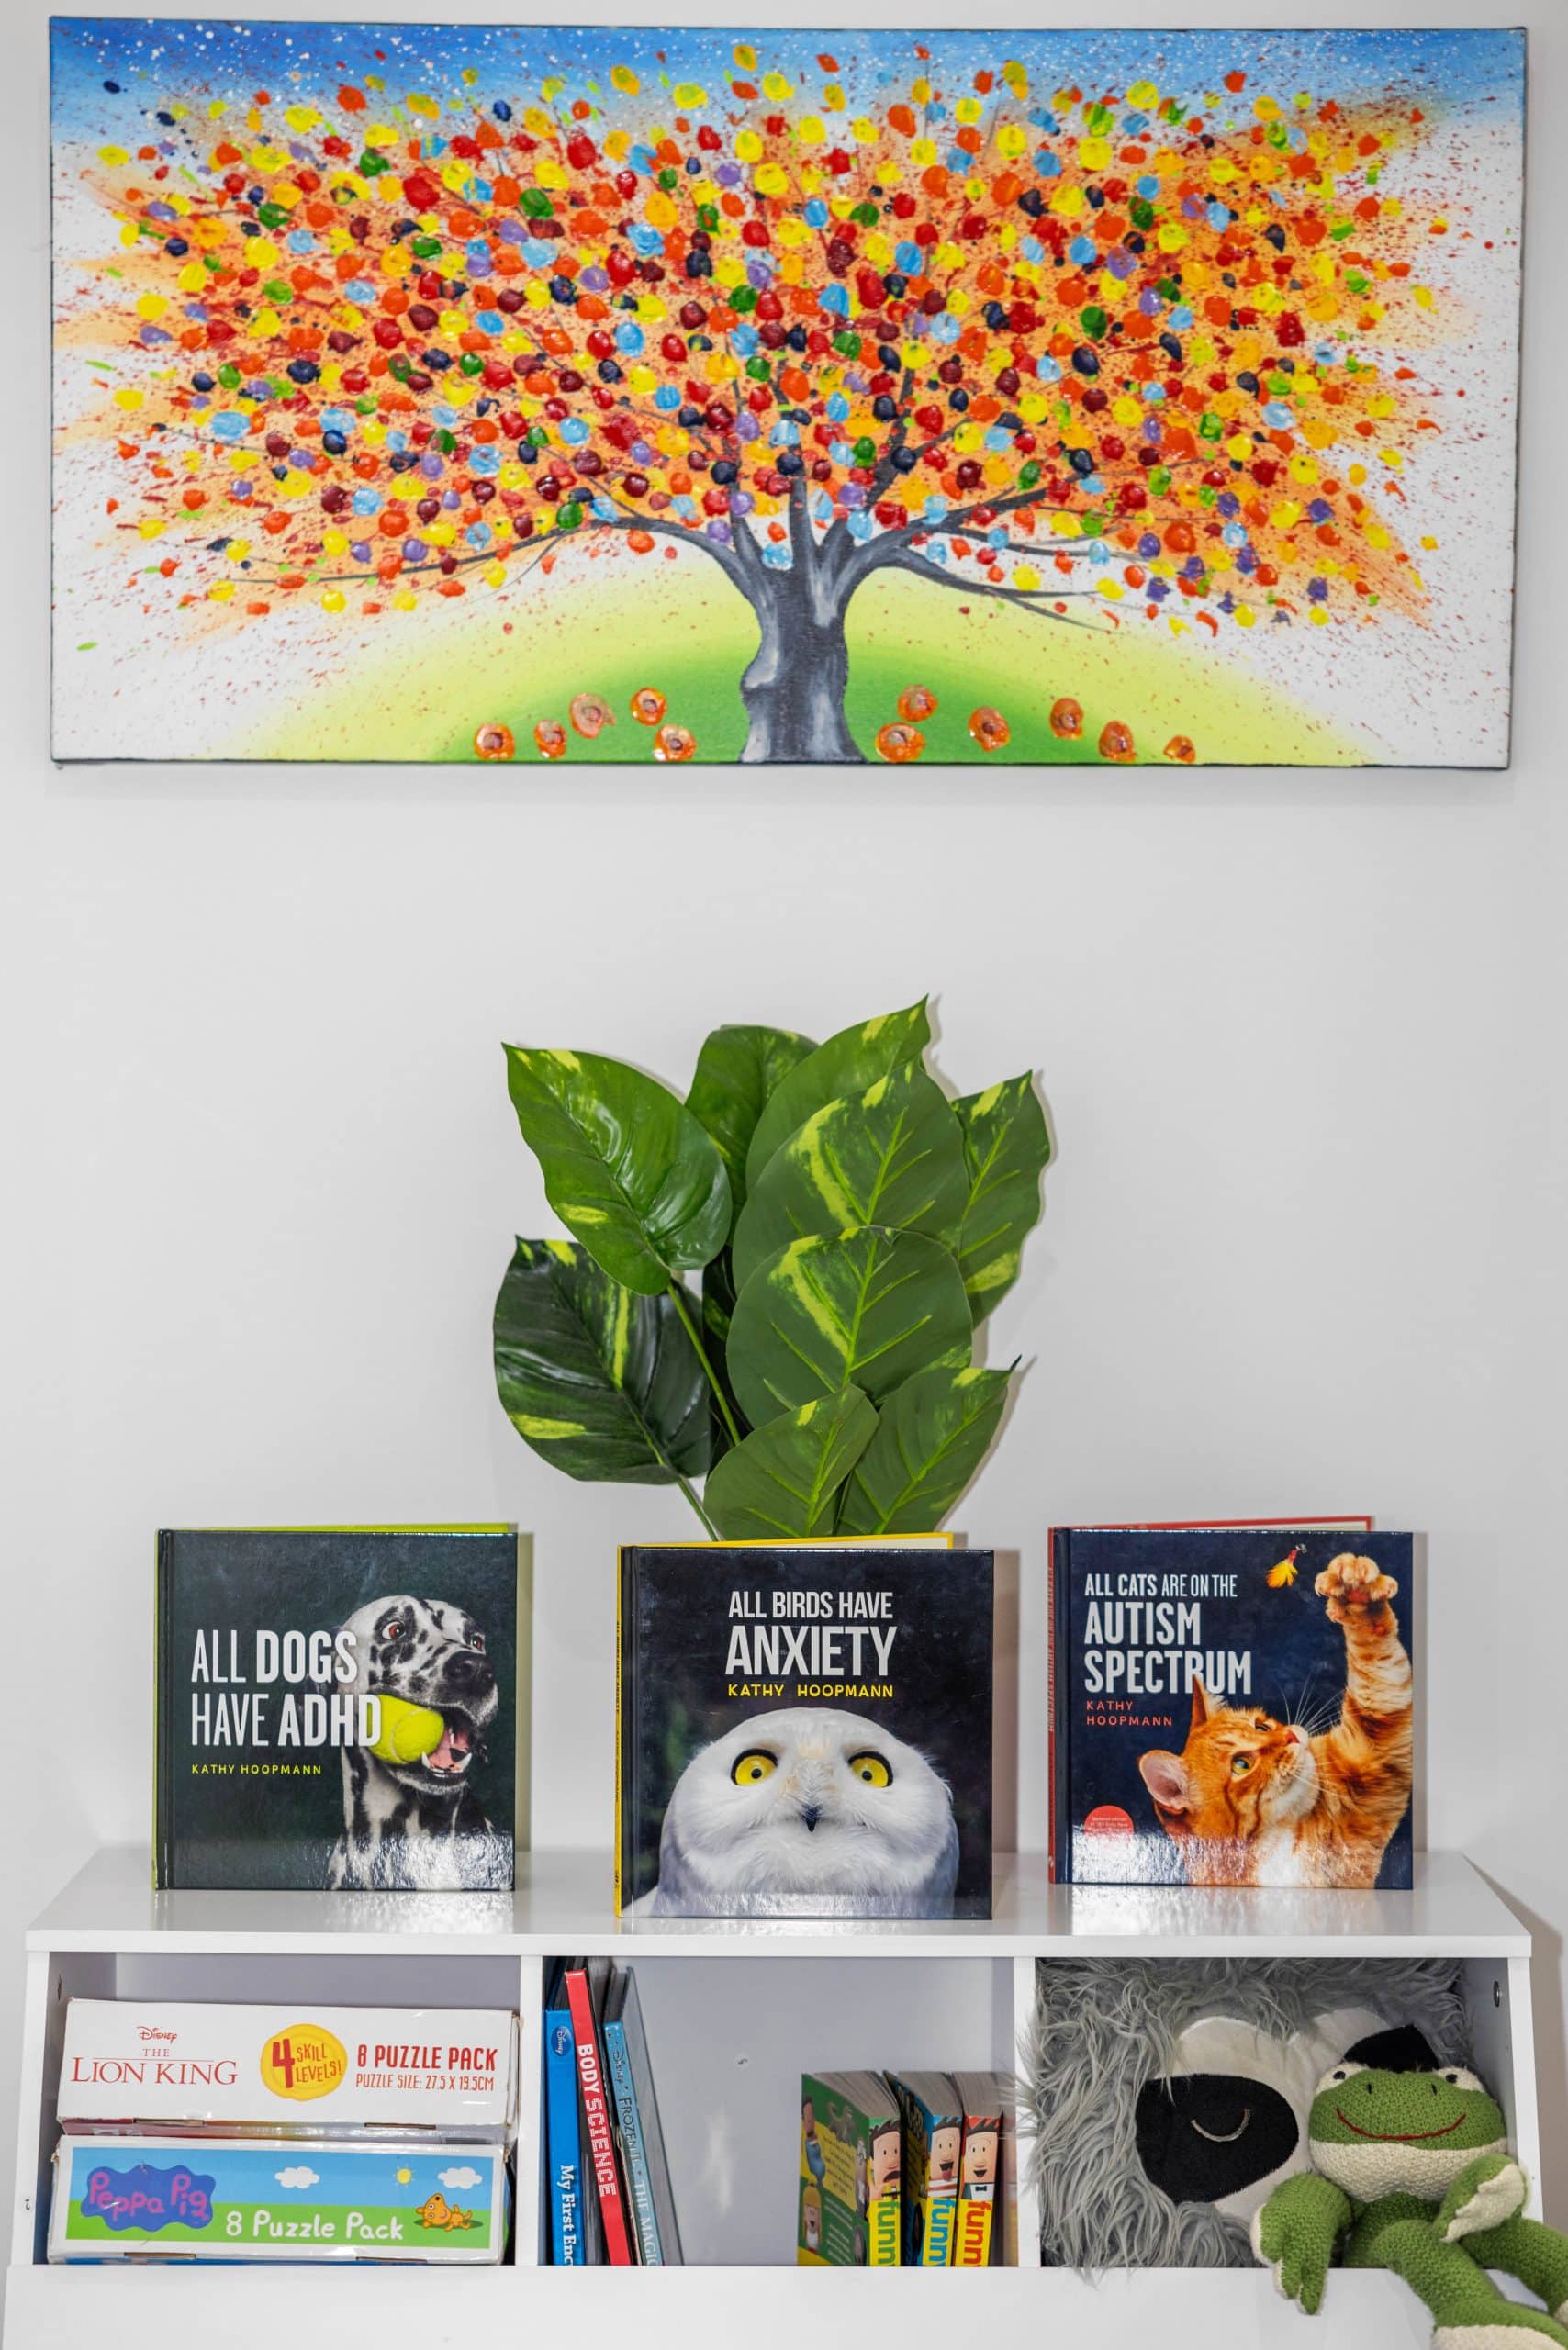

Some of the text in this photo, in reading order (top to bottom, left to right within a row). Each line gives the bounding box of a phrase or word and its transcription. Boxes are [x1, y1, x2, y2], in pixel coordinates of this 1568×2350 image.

[1084, 1574, 1238, 1597] ALL CATS ARE ON THE
[728, 1591, 893, 1619] ALL BIRDS HAVE
[1084, 1602, 1201, 1645] AUTISM
[191, 1629, 357, 1684] ALL DOGS
[725, 1626, 897, 1676] ANXIETY
[728, 1684, 894, 1698] KATHY HOOPMANN
[1084, 1650, 1251, 1695] SPECTRUM
[191, 1694, 380, 1747] HAVE ADHD
[1086, 1700, 1134, 1711] KATHY
[1086, 1715, 1172, 1727] HOOPMANN
[191, 1764, 322, 1775] KATHY HOOPMANN
[71, 2056, 240, 2086] LION KING
[142, 2048, 170, 2058] THE
[272, 2038, 330, 2089] 4 SKILL
[295, 2059, 343, 2083] LEVELS!
[356, 2043, 498, 2072] 8 PUZZLE PACK
[356, 2073, 395, 2089] PUZZLE
[398, 2074, 422, 2089] SIZE:
[425, 2074, 447, 2090] 27.5
[449, 2076, 456, 2090] X
[577, 2043, 616, 2198] BODY SCIENCE
[618, 2097, 636, 2150] FROZEN
[89, 2171, 209, 2221] Peppa Pig
[558, 2165, 574, 2190] My
[226, 2210, 404, 2241] 8 Puzzle Pack
[562, 2193, 577, 2239] First
[877, 2199, 900, 2266] funn
[929, 2199, 957, 2266] funn
[963, 2200, 992, 2266] funn
